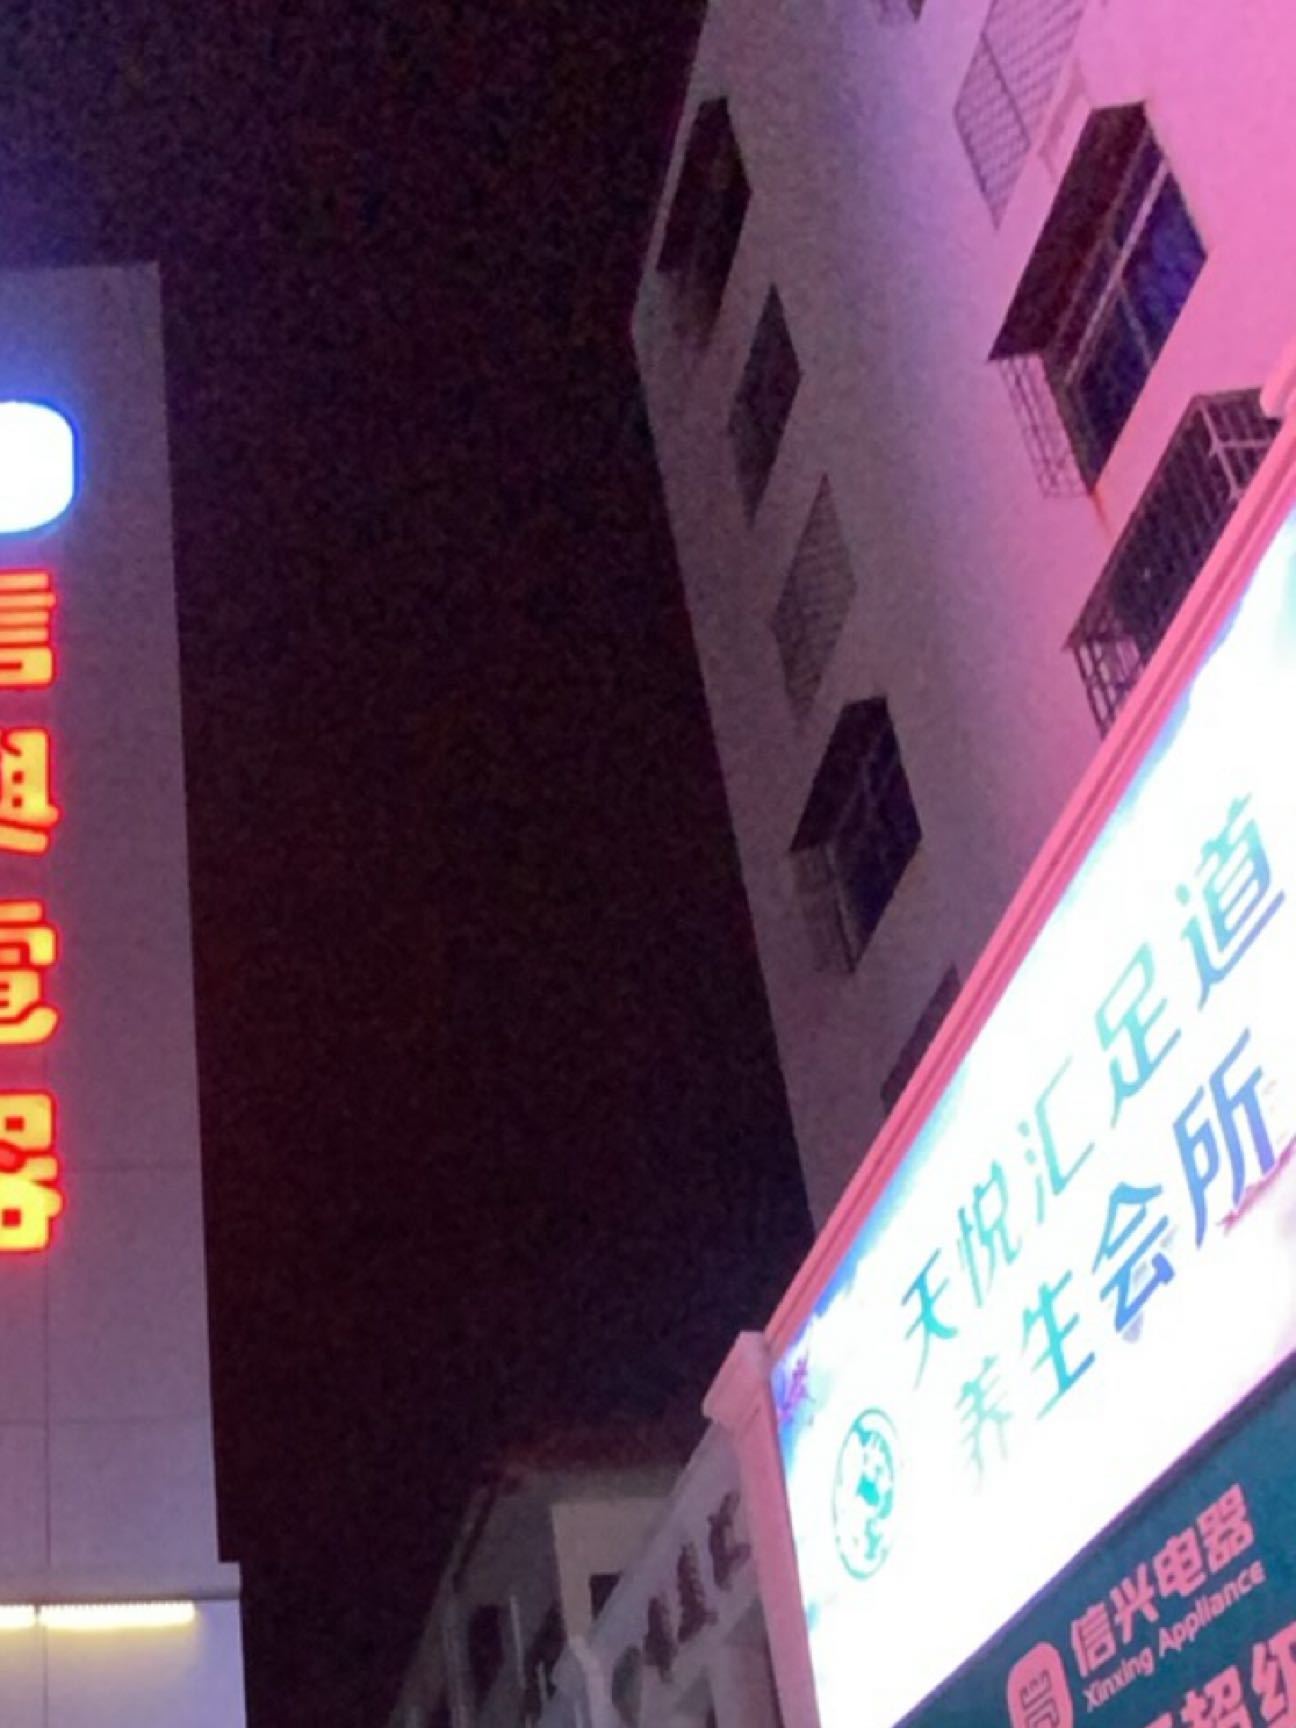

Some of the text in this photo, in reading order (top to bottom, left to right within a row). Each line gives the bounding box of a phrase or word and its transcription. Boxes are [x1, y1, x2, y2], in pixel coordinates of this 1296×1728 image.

[902, 792, 1285, 1389] 天悦汇足道
[956, 1027, 1276, 1490] 养生会所
[1071, 1482, 1253, 1678] 信兴电器
[1082, 1560, 1267, 1713] Xinxing Appliance
